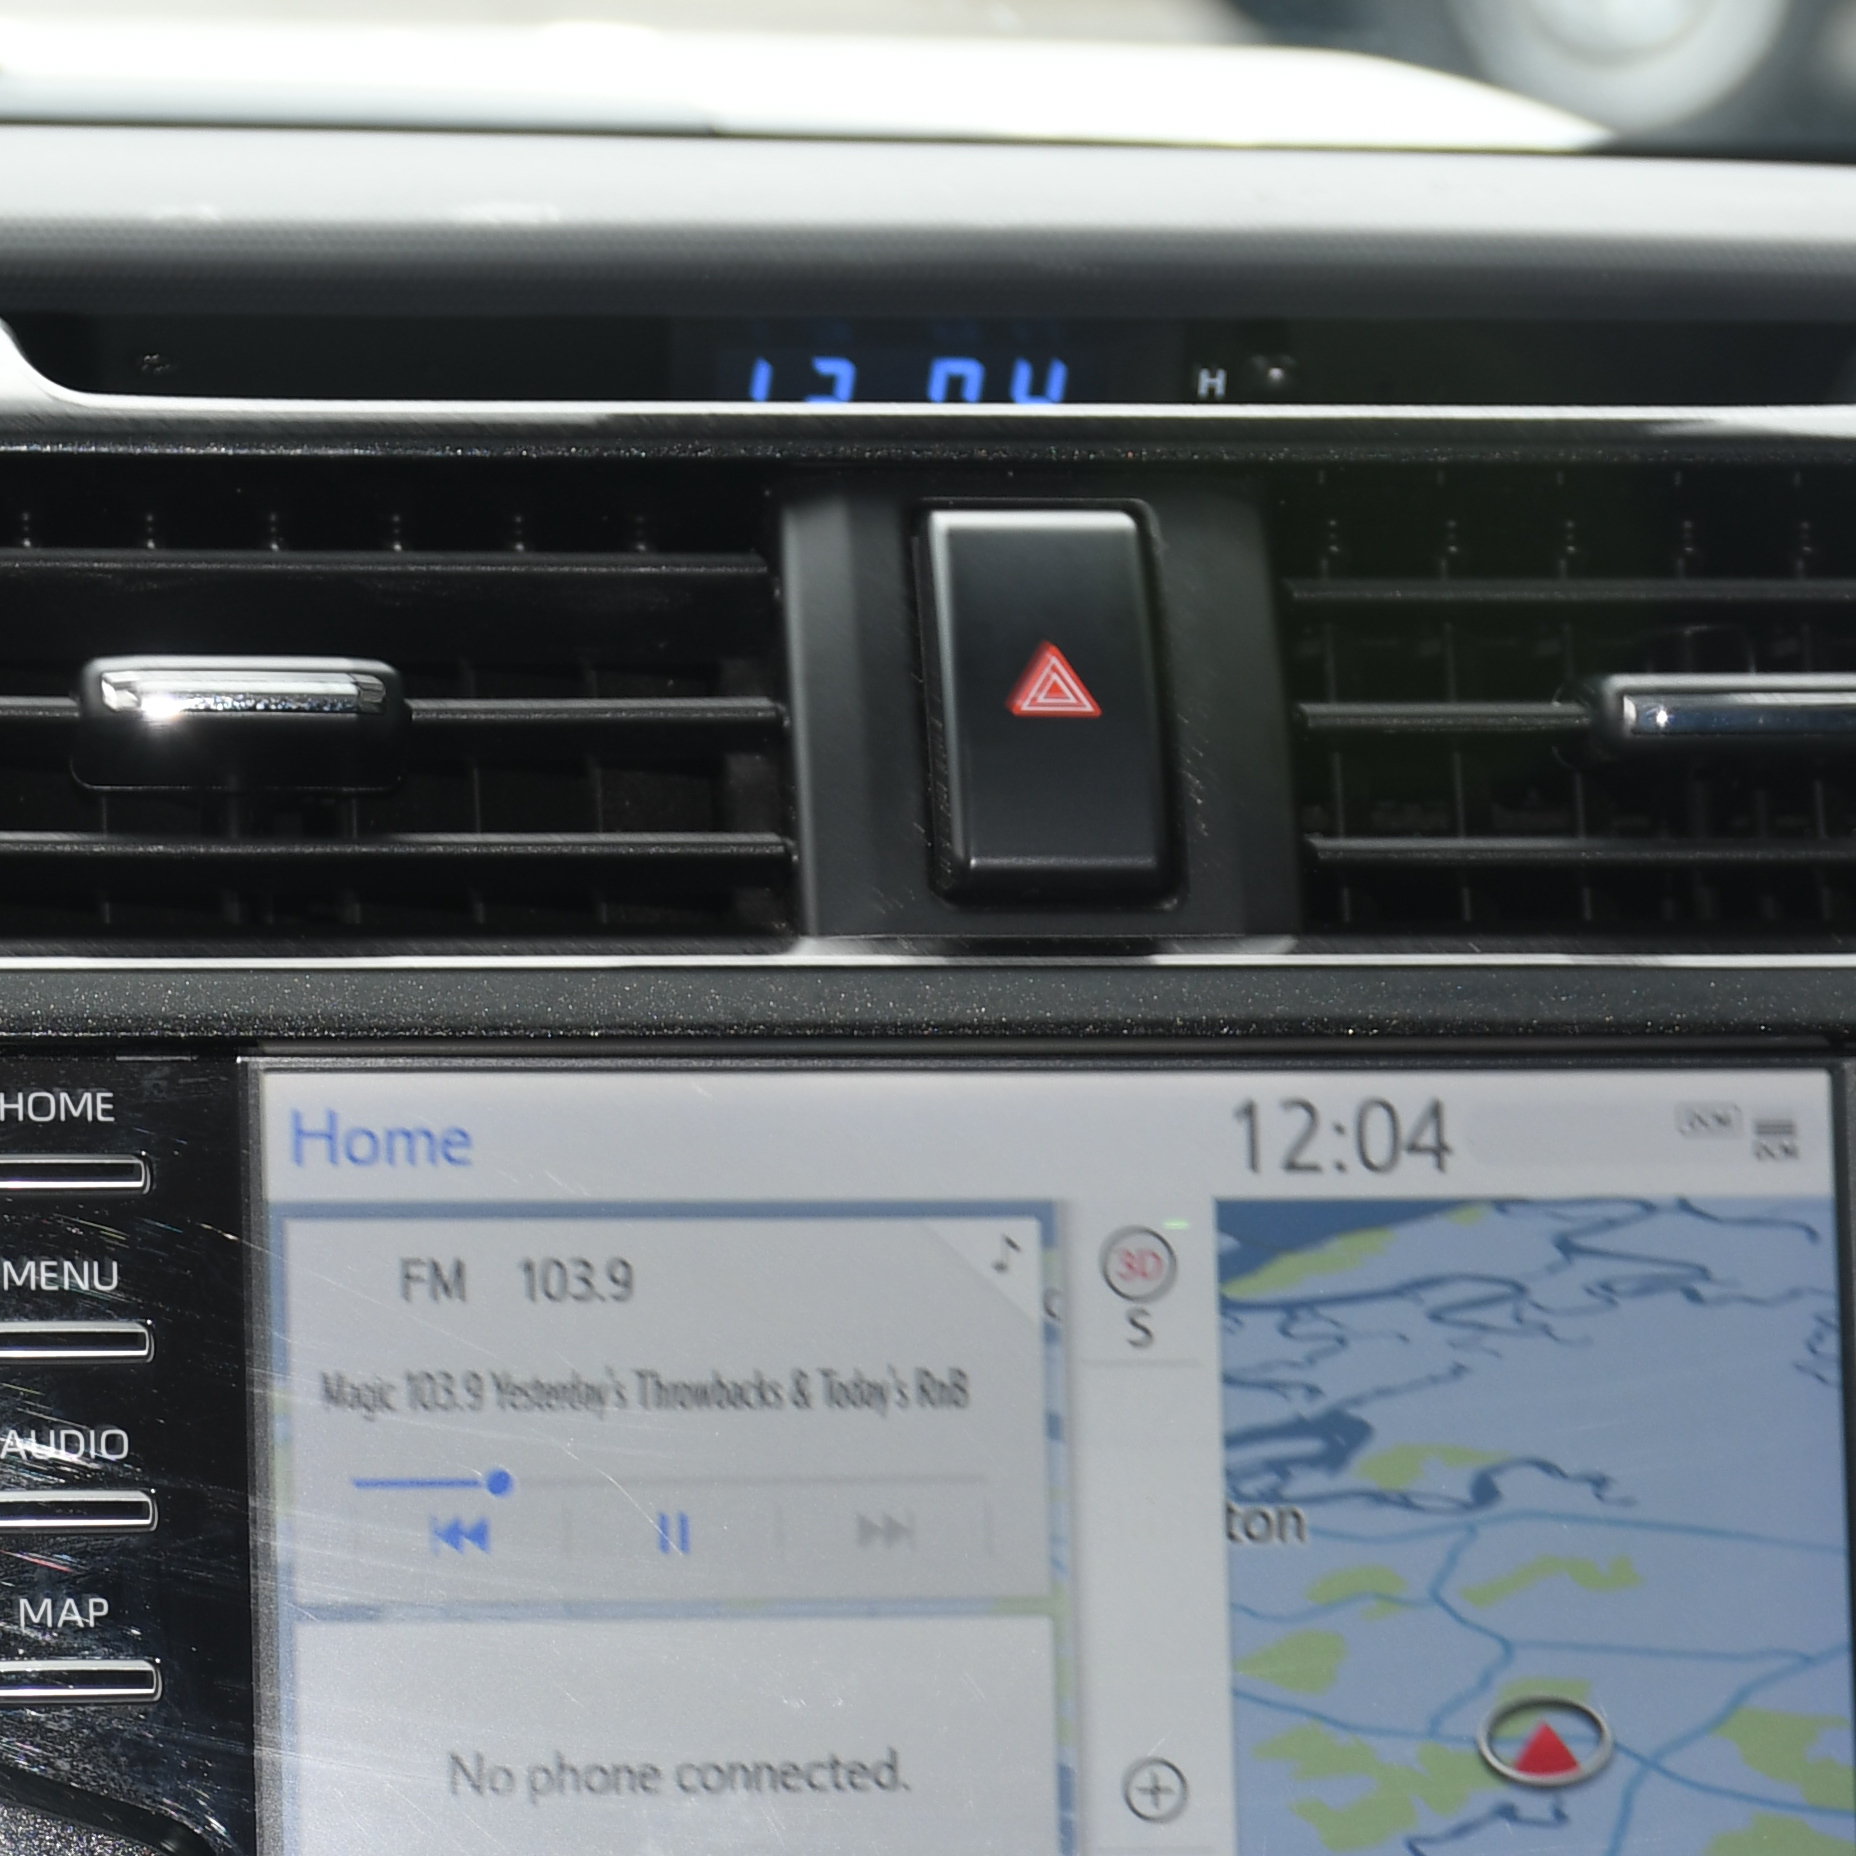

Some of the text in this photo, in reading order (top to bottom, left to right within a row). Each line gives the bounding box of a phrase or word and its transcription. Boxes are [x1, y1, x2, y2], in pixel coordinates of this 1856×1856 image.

[290, 1109, 474, 1167] Home
[1235, 1097, 1452, 1174] 12:04
[1, 1260, 118, 1291] MENU
[400, 1257, 634, 1302] FM 103.9
[1126, 1306, 1153, 1348] S
[321, 1370, 396, 1422] Magic
[405, 1370, 483, 1412] 103.9
[492, 1366, 628, 1421] Yesterday's
[634, 1368, 784, 1411] Throwbacks
[790, 1368, 812, 1410] &
[817, 1364, 910, 1419] Today's
[0, 1429, 129, 1461] AUDIO
[18, 1597, 110, 1629] MAP
[448, 1746, 912, 1805] No phone connected.
